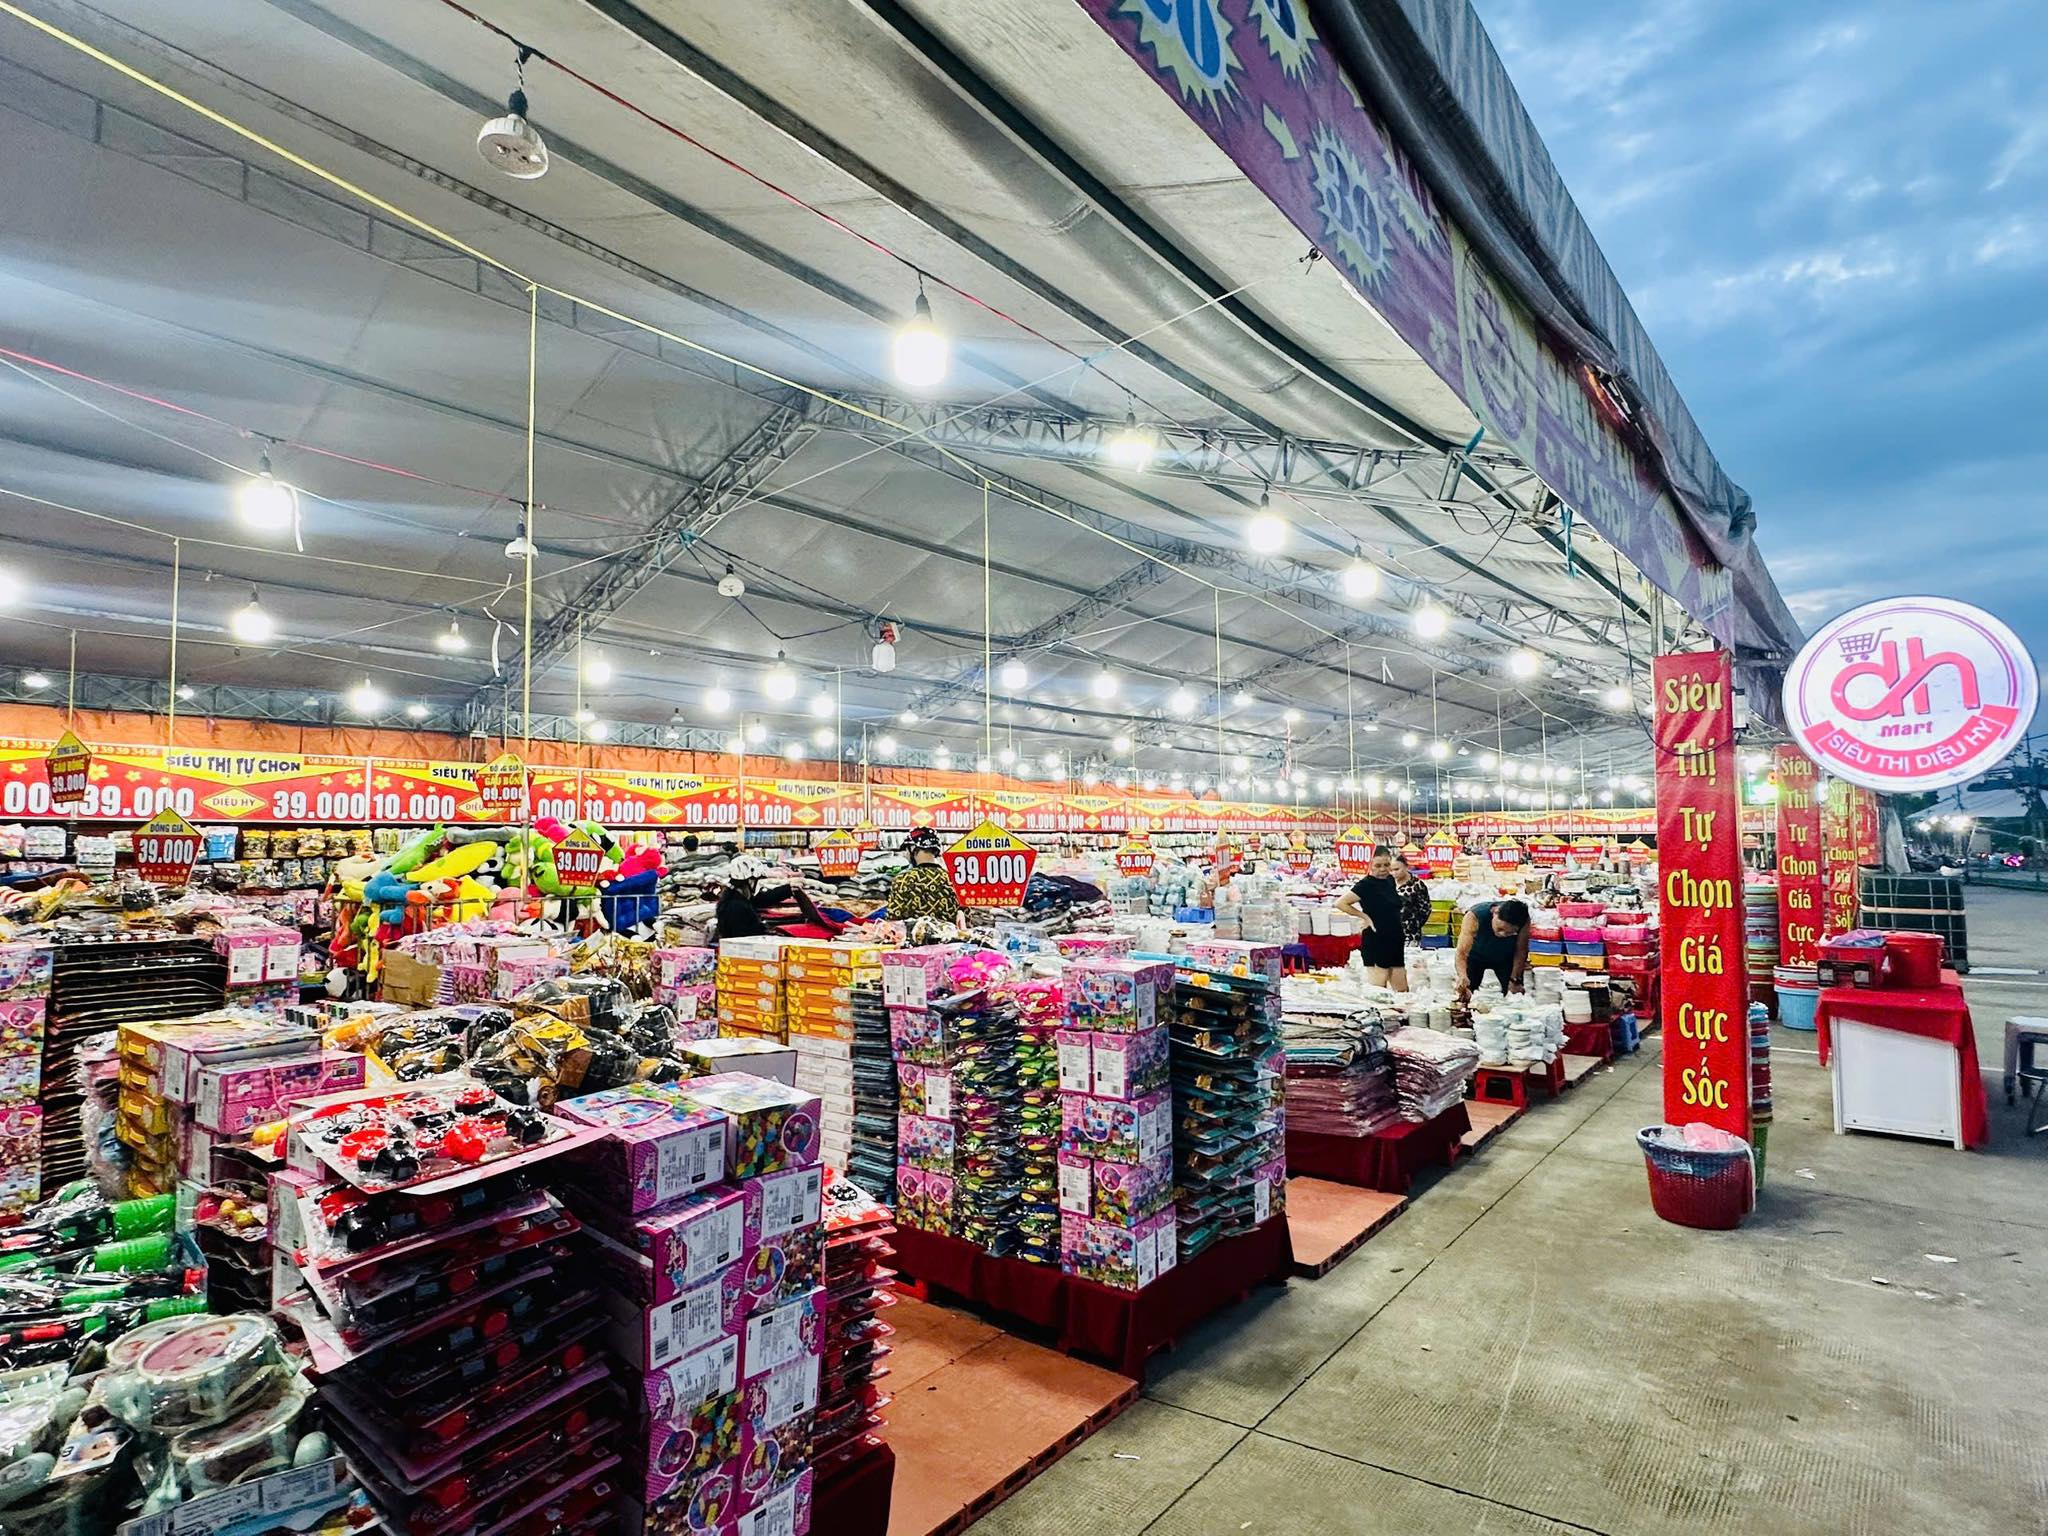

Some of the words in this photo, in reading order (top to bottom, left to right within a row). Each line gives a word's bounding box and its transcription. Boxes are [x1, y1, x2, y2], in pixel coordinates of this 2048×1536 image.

[1831, 637, 1981, 721] dh
[1665, 678, 1723, 714] Siêu
[1880, 721, 1933, 738] mart
[1828, 735, 1872, 764] SIÊU
[1876, 754, 1910, 773] THỊ
[1916, 743, 1966, 770] DIỆU
[1964, 719, 1993, 745] HY
[166, 754, 202, 767] SIÊU
[207, 757, 231, 777] THỊ
[236, 758, 255, 777] TỰ
[258, 760, 300, 774] CHỌN
[1673, 737, 1717, 786] Thị
[1781, 755, 1812, 776] Siêu
[52, 773, 86, 793] 39.000
[432, 767, 458, 779] SIÊU
[628, 777, 648, 787] SIÊU
[650, 778, 664, 790] THỊ
[666, 779, 678, 791] TỰ
[678, 780, 702, 789] CHỌN
[794, 785, 806, 795] THỊ
[79, 785, 195, 817] 39.000
[272, 790, 366, 819] 39.000
[373, 793, 456, 820] 10.000
[584, 799, 646, 823] 10.000
[1787, 788, 1809, 814] Thị
[685, 803, 738, 824] 10.000
[743, 804, 792, 825] 10.000
[822, 806, 865, 827] 10.000
[872, 808, 911, 826] 10.000
[935, 809, 970, 827] 10.000
[1026, 812, 1055, 829] 10.000
[1057, 814, 1085, 830] 10.000
[1101, 815, 1126, 830] 10.000
[172, 822, 184, 832] GIÁ
[1680, 806, 1714, 850] Tự
[1788, 823, 1808, 847] Tự
[138, 838, 194, 864] 39.000
[966, 836, 992, 849] ĐỒNG
[995, 836, 1011, 848] GIÁ
[1338, 843, 1371, 862] 10.000
[557, 851, 598, 874] 39.000
[820, 847, 859, 864] 39.000
[1120, 855, 1152, 868] 20.000
[1427, 846, 1453, 862] 15.000
[1490, 849, 1518, 862] 10.000
[1829, 847, 1855, 864] Chọn
[953, 854, 1027, 886] 39.000
[1781, 855, 1818, 881] Chọn
[1666, 868, 1734, 919] Chọn
[1788, 889, 1812, 909] Giá
[1834, 891, 1853, 909] Cực
[1787, 922, 1816, 946] Cực
[1680, 935, 1724, 975] Giá
[1679, 1002, 1729, 1051] Cực
[1682, 1055, 1729, 1110] Sốc
